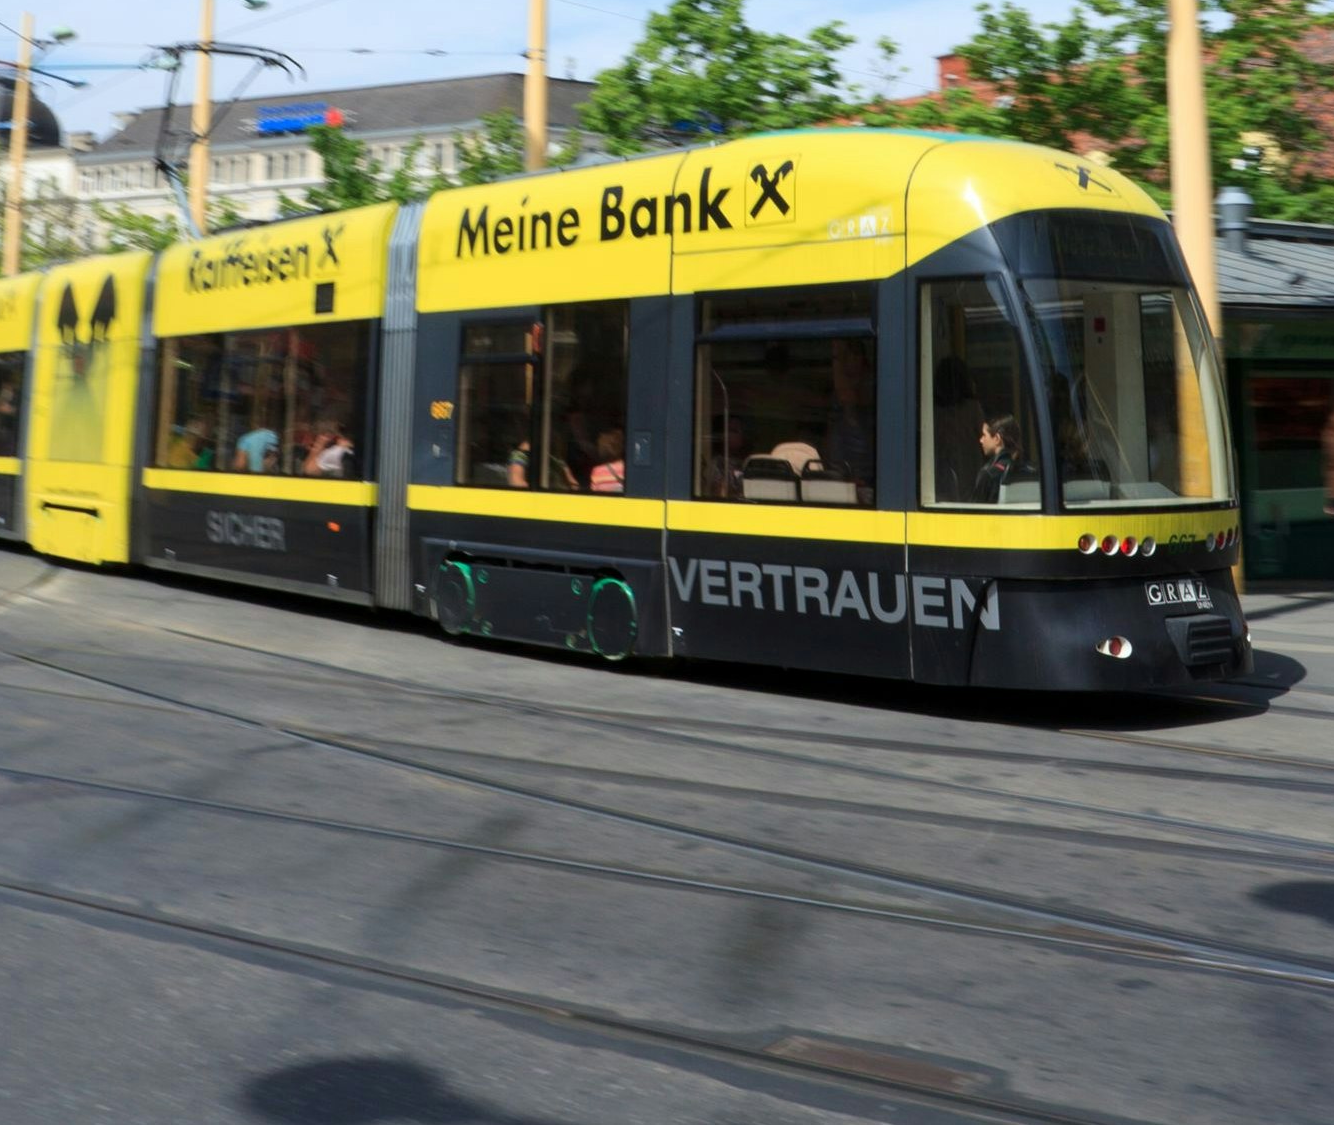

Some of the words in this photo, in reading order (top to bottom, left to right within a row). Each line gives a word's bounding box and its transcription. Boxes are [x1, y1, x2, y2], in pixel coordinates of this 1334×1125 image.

[456, 196, 580, 258] Meine
[600, 166, 733, 241] Bank
[1169, 534, 1196, 555] 667
[668, 556, 1000, 631] VERTRAUEN
[1146, 580, 1210, 605] GRAZ
